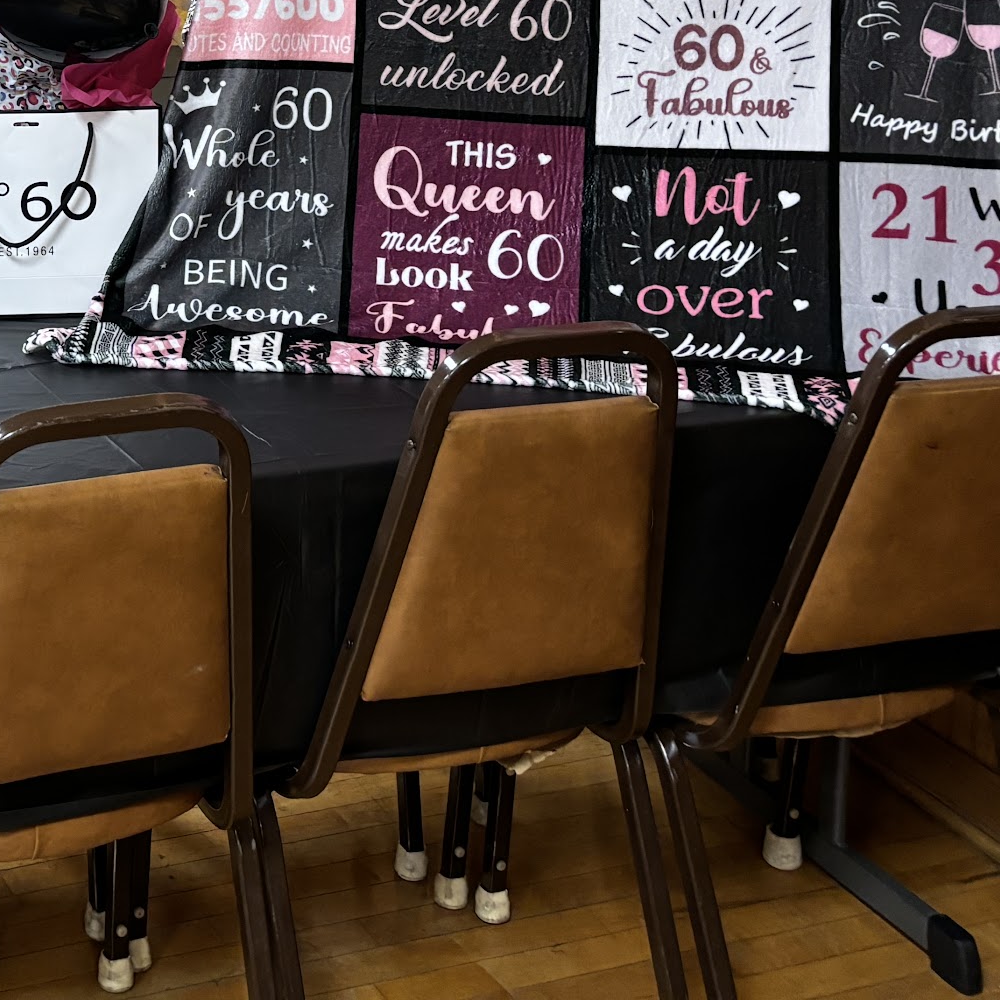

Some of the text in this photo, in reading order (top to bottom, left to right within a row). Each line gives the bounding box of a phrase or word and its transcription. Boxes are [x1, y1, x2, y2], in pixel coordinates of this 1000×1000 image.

[232, 32, 266, 53] AND
[270, 33, 351, 54] COUNTING
[673, 24, 772, 75] 60 &
[380, 53, 566, 99] unlocked
[637, 69, 797, 119] Fabulous
[272, 87, 333, 132] 60
[850, 102, 939, 143] Happy
[164, 123, 280, 171] Whole
[445, 140, 517, 170] THIS
[373, 145, 556, 221] Queen
[655, 166, 761, 226] Not
[169, 187, 334, 241] OF years
[871, 182, 957, 243] 21
[380, 213, 565, 282] makes 60
[654, 227, 761, 277] a day
[183, 259, 288, 291] BEING
[127, 284, 335, 327] Awesome
[637, 285, 774, 320] over
[647, 327, 813, 367] bulous
